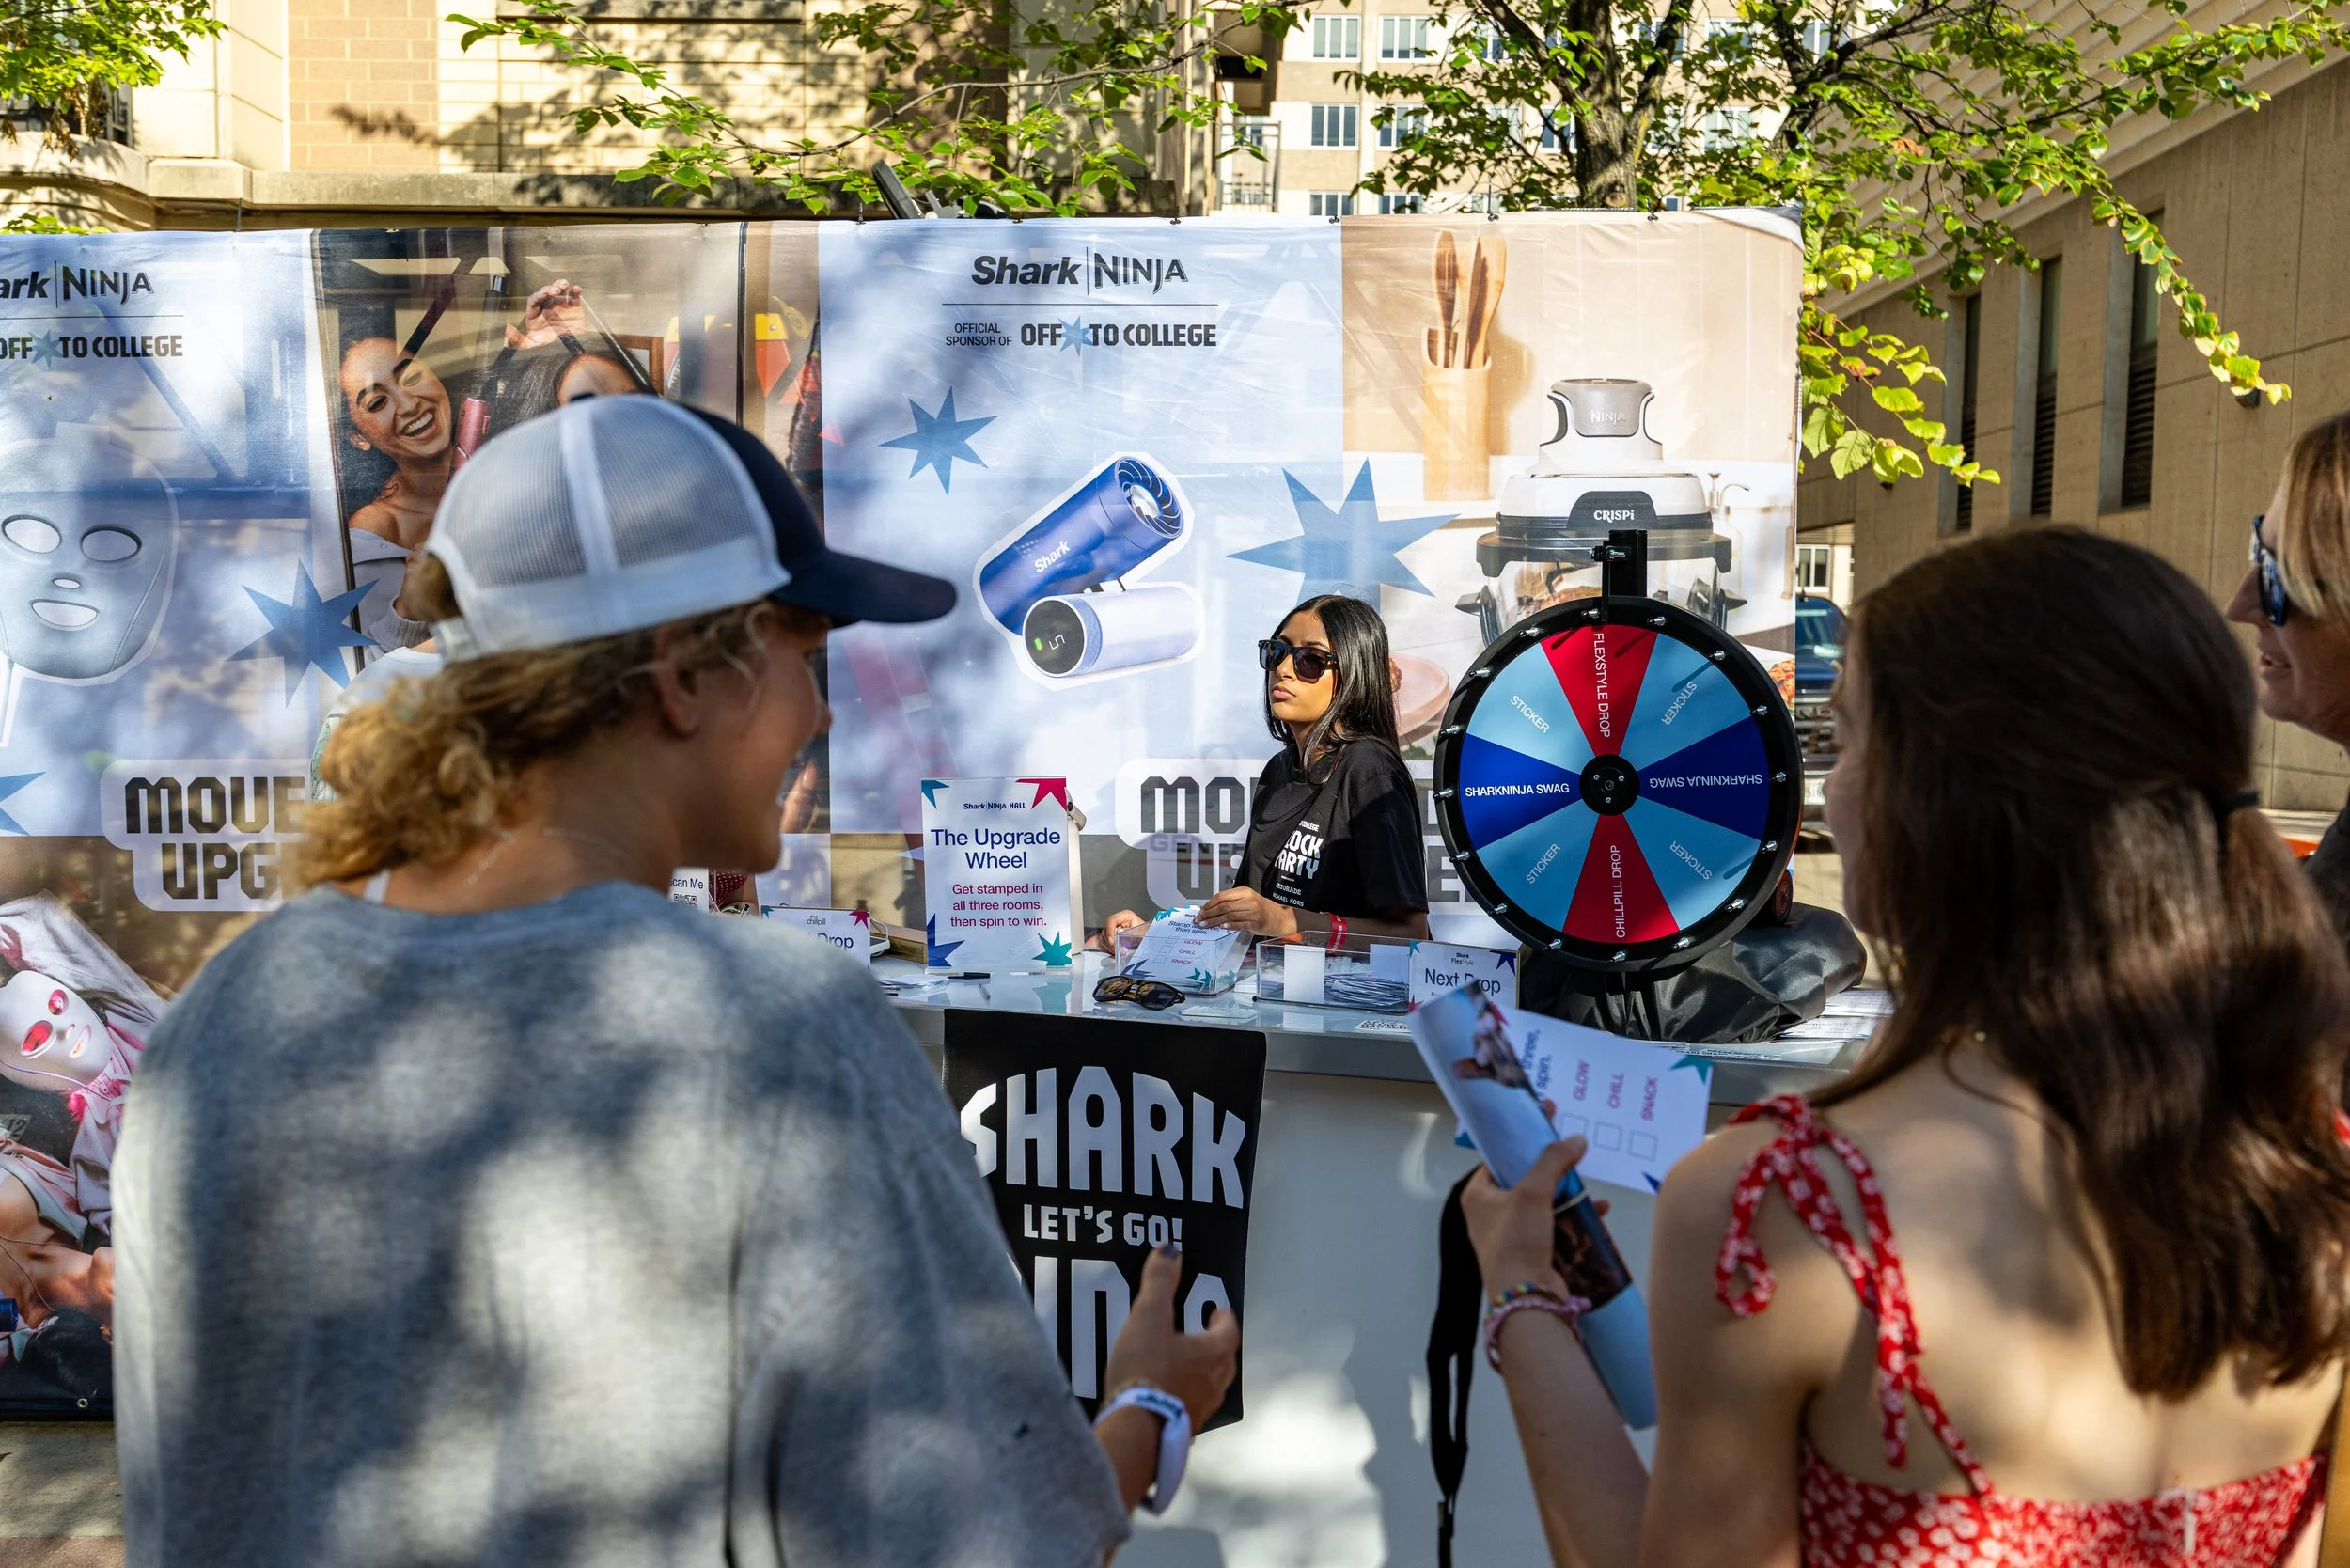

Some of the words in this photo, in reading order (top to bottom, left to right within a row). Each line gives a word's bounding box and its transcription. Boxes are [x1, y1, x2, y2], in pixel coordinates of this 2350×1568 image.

[62, 266, 154, 306] NINJA
[971, 255, 1082, 286] Shark
[1094, 252, 1188, 294] NINJA
[946, 336, 995, 347] SPONSOR
[997, 336, 1012, 347] OF
[954, 322, 1001, 334] OFFICIAL
[1021, 323, 1062, 346] OFF
[1089, 323, 1119, 346] TO
[1123, 323, 1217, 347] COLLEGE
[59, 337, 88, 359] TO
[92, 335, 183, 358] COLLEGE
[1590, 409, 1627, 425] NINJA
[1034, 541, 1071, 572] Shark
[1593, 633, 1608, 699] FLEXSTYLE
[1511, 695, 1550, 734] STICKER
[1660, 681, 1698, 726] STICKER
[1598, 703, 1610, 738] DROP
[1465, 784, 1534, 797] SHARKNINJA
[1536, 783, 1570, 794] SWAG
[1649, 776, 1684, 789] SWAG
[1687, 774, 1763, 787] SHARKNINJA
[988, 802, 1007, 810] NINJA
[1141, 776, 1256, 834] MO
[931, 829, 968, 846] The
[974, 828, 1061, 849] Upgrade
[162, 842, 280, 899] UPG
[965, 852, 1026, 869] Wheel
[1274, 849, 1320, 880] ARTY
[1526, 843, 1561, 884] STICKER
[1610, 844, 1622, 879] DROP
[1669, 840, 1713, 881] STICKER
[690, 878, 704, 889] Me
[952, 884, 974, 894] Get
[977, 884, 1029, 896] stamped
[1032, 884, 1042, 894] in
[952, 901, 965, 911] all
[969, 901, 999, 911] three
[1002, 902, 1043, 911] rooms,
[1289, 898, 1305, 907] KORS
[1612, 881, 1626, 938] CHILLPILL
[950, 916, 976, 927] then
[979, 916, 1005, 929] spin
[1008, 917, 1019, 927] to
[1023, 916, 1047, 926] win.
[1168, 920, 1191, 929] Stamp
[1451, 957, 1475, 965] FlexStyle
[1425, 967, 1460, 987] Next
[1573, 1059, 1590, 1101] GLOW
[1607, 1073, 1625, 1109] CHILL
[1640, 1076, 1659, 1122] SNACK
[960, 1065, 1246, 1210] SHARK
[1024, 1203, 1113, 1244] LET'S
[1122, 1211, 1183, 1252] GO!
